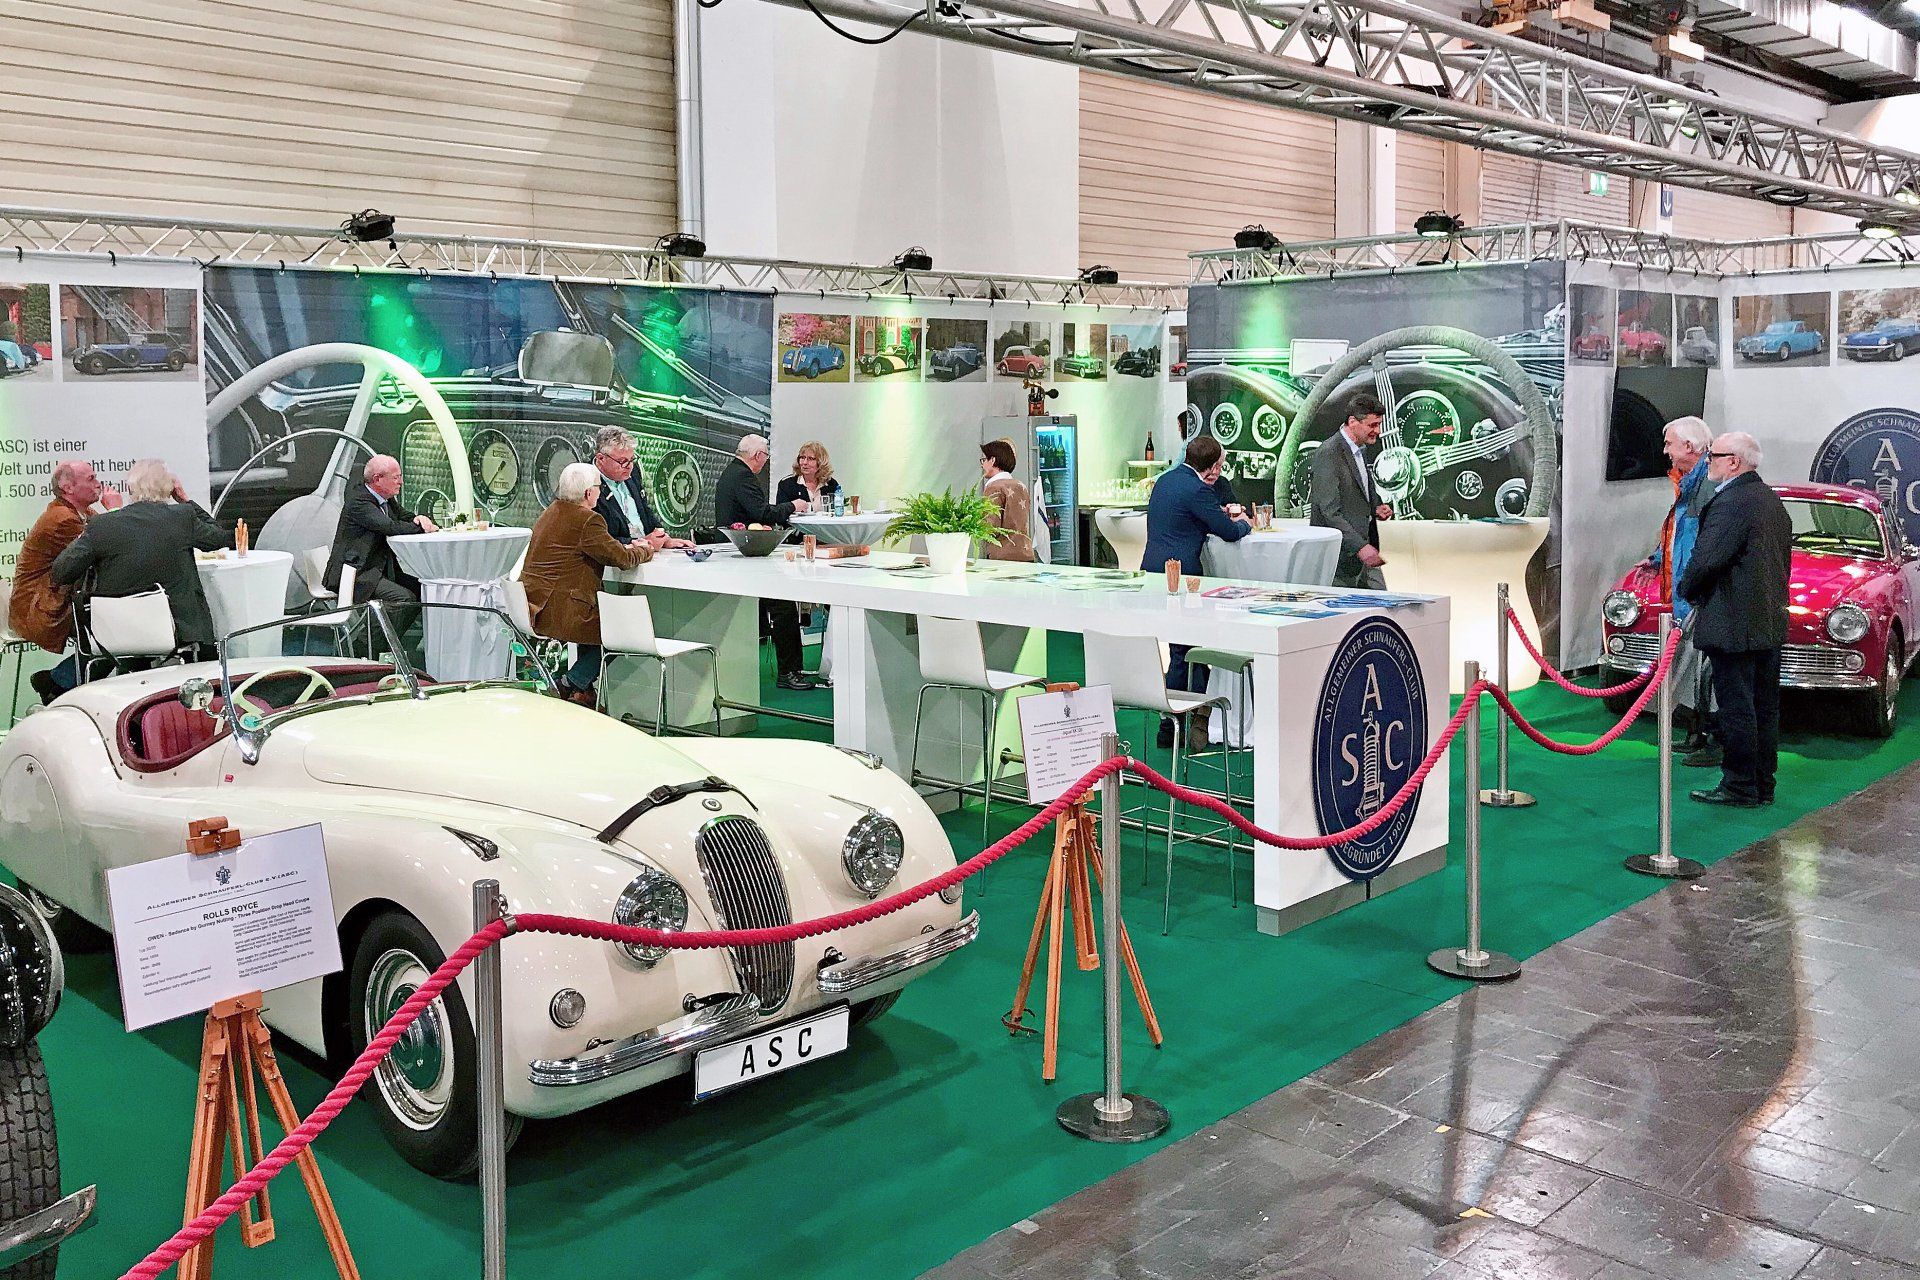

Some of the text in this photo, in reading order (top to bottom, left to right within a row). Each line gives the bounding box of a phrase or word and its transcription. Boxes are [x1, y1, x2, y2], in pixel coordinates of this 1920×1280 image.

[33, 439, 50, 453] ist
[53, 438, 87, 452] einer
[1871, 438, 1902, 471] A
[26, 461, 51, 475] und
[108, 459, 136, 472] heu
[1324, 631, 1419, 724] ALLGEMEINER SCHNAUFERL-CLUB
[1388, 812, 1407, 846] 1900
[202, 900, 259, 921] ROLLS ROYCE
[147, 933, 165, 942] OWEN
